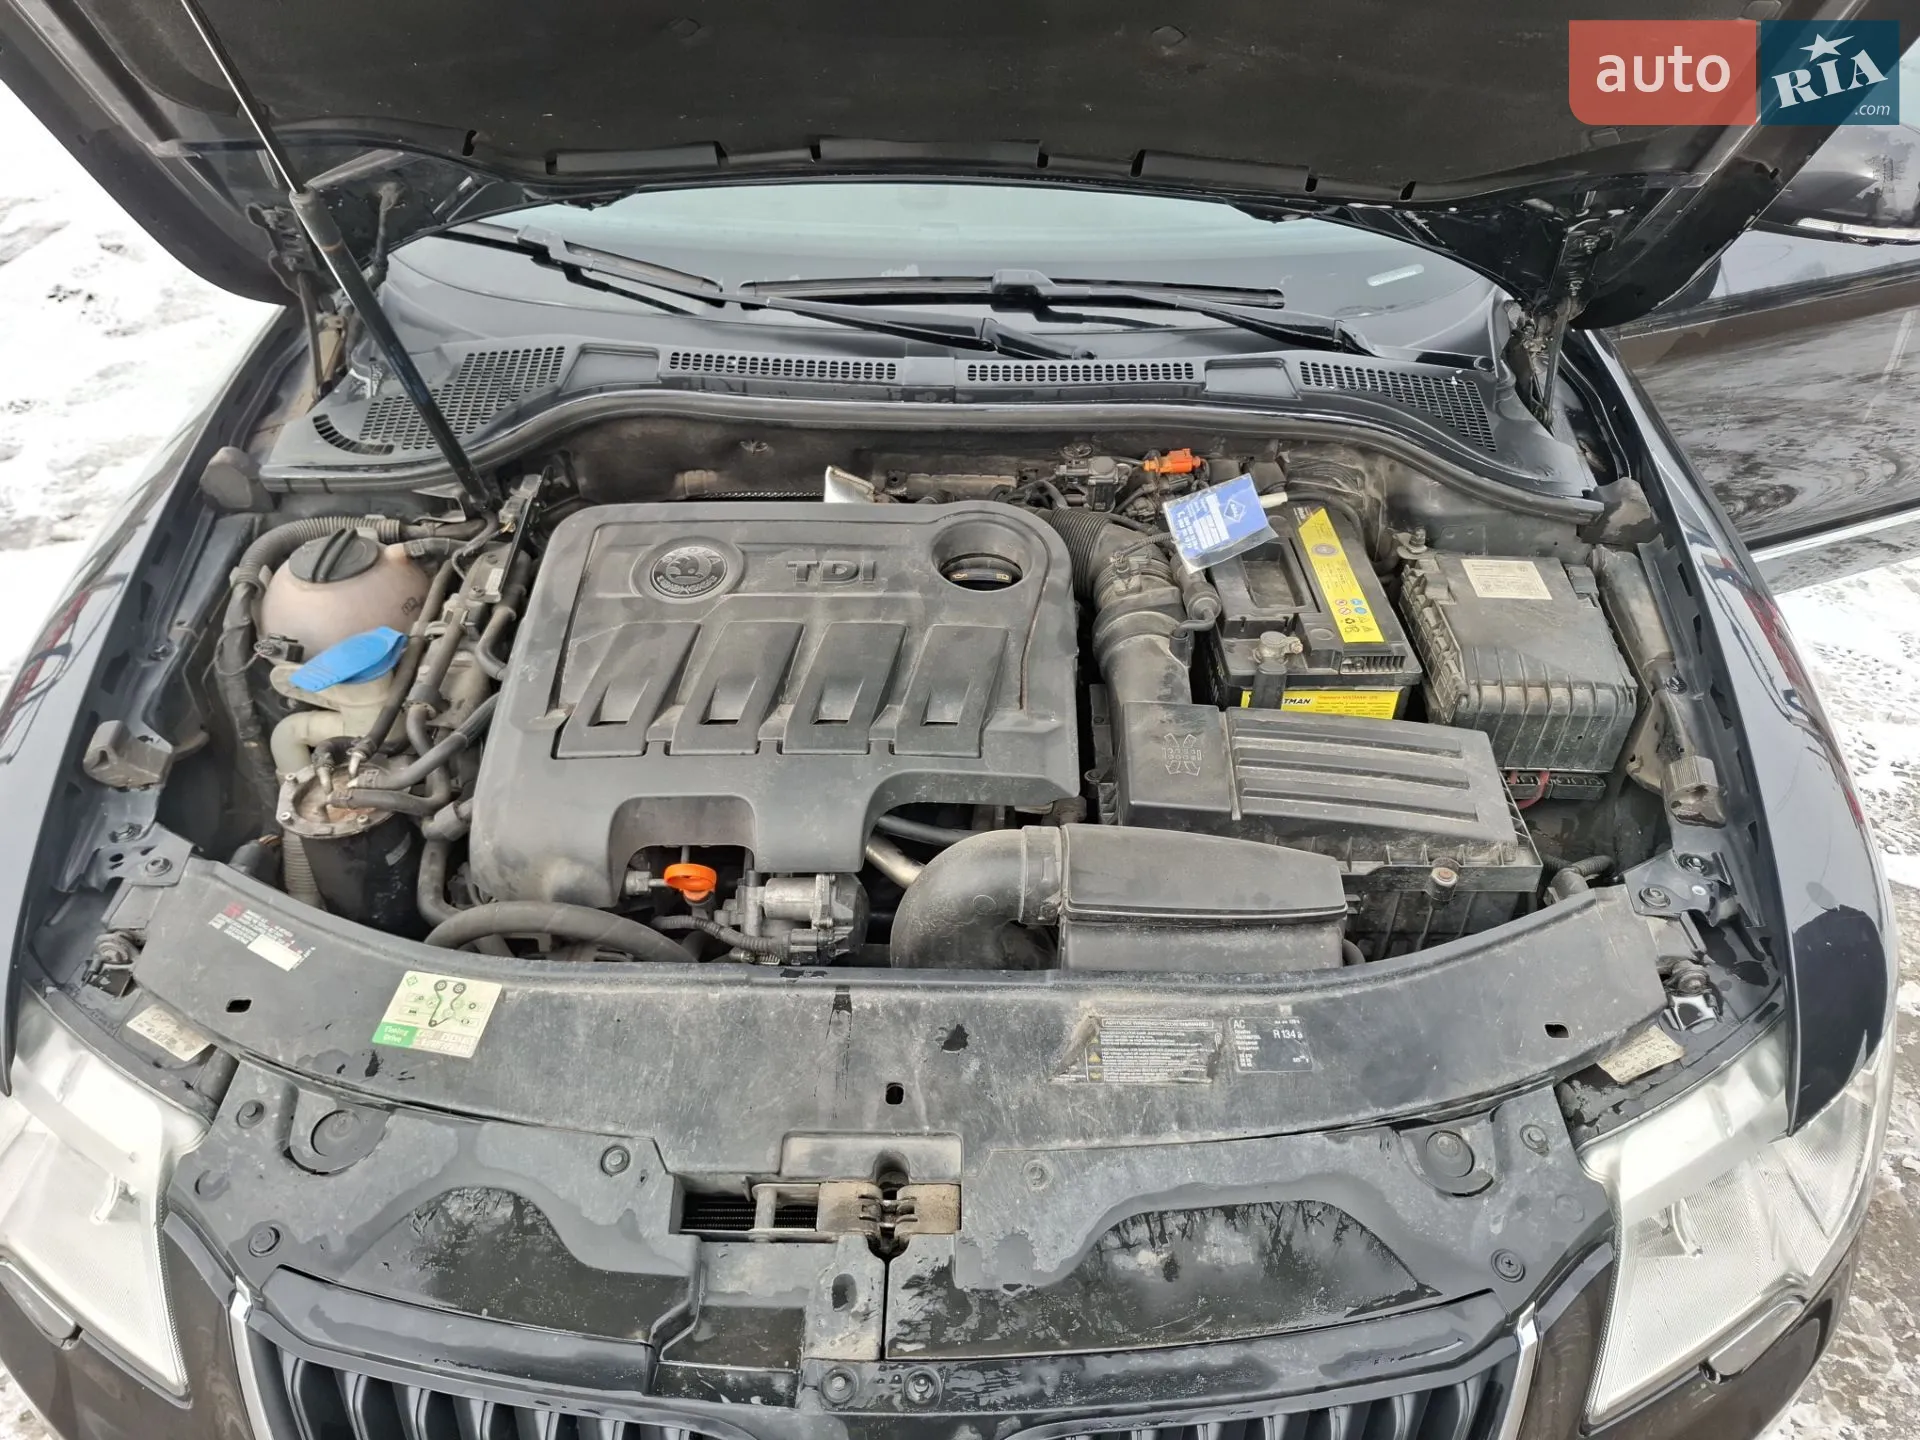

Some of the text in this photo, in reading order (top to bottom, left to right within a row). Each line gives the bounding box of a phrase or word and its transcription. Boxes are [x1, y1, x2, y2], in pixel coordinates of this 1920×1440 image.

[787, 559, 877, 585] TDI
[1234, 1019, 1246, 1029] AC
[1272, 1029, 1281, 1039] R
